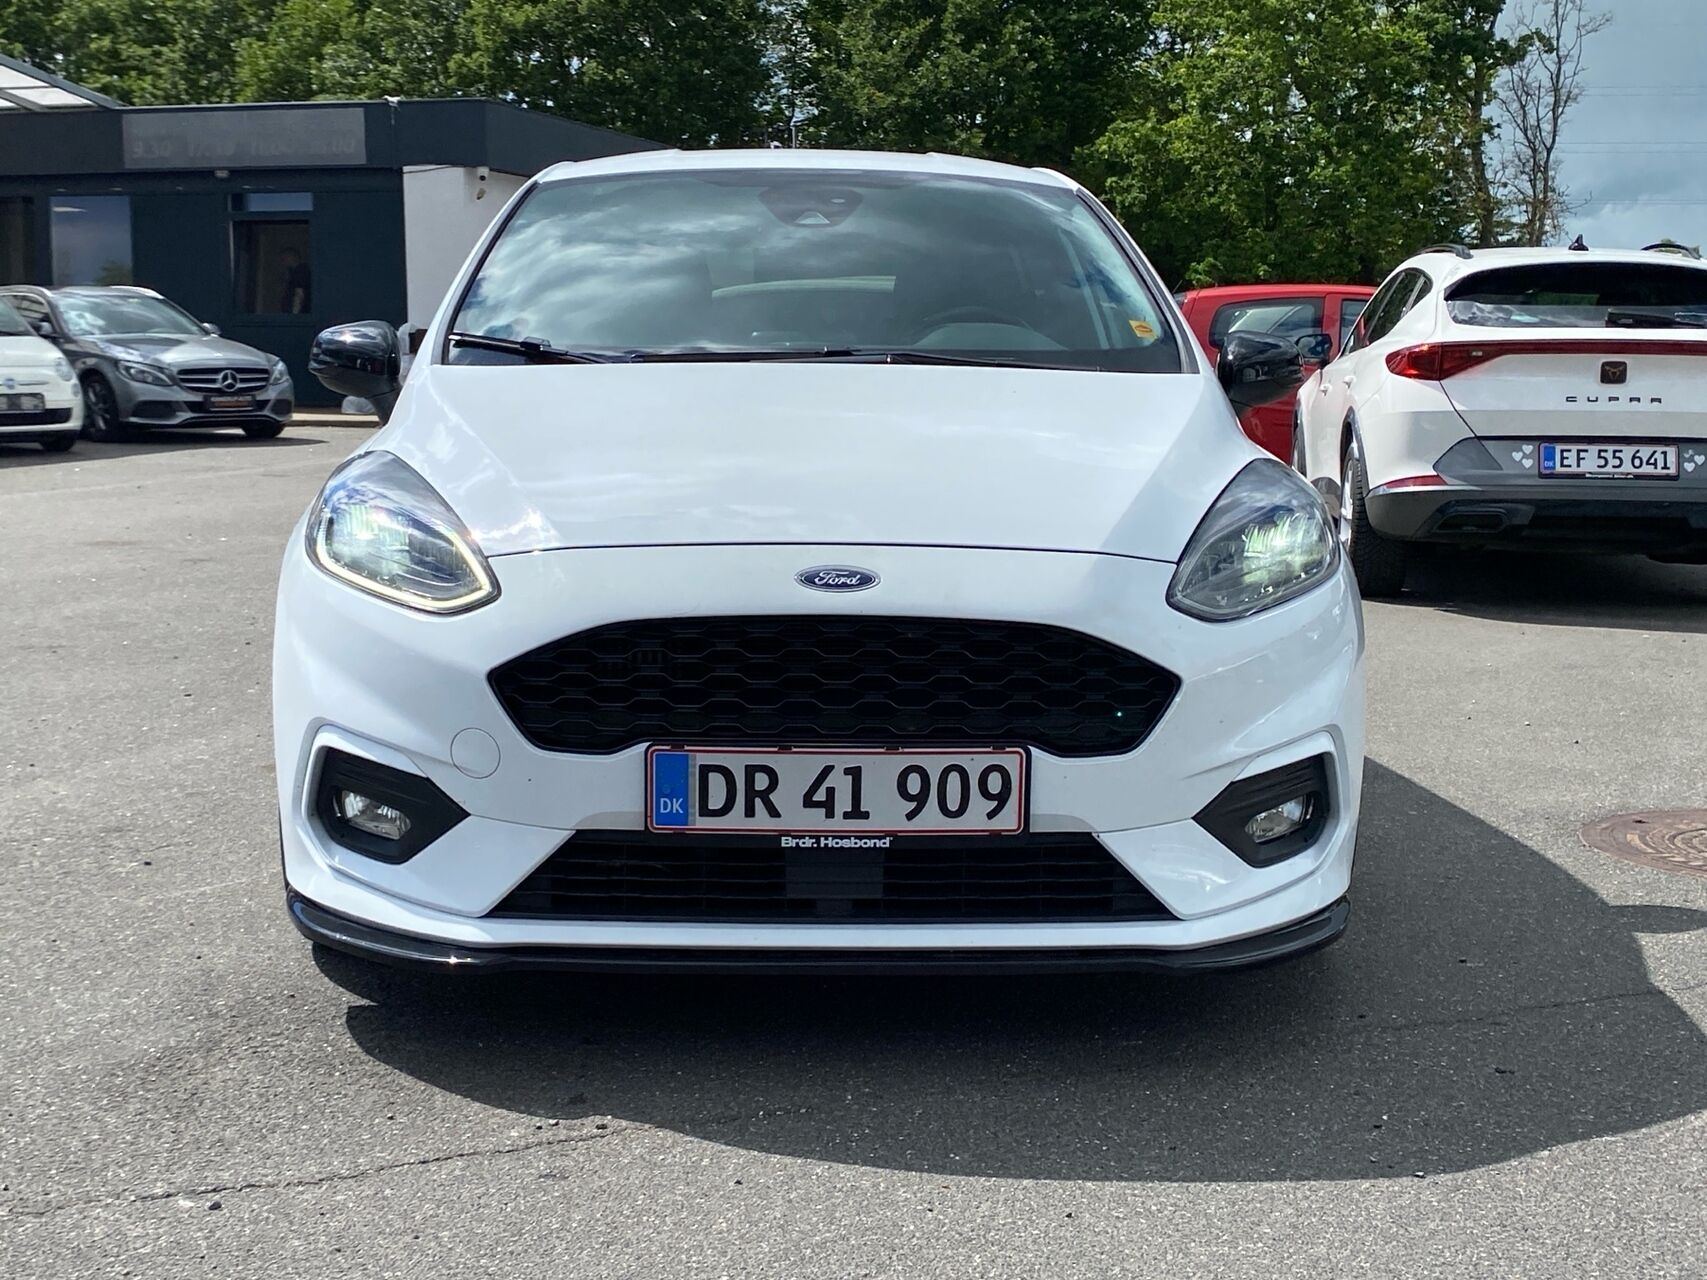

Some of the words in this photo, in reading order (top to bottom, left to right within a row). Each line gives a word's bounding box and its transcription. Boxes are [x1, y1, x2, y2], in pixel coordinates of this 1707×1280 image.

[1565, 396, 1662, 404] CUPRA
[1559, 449, 1588, 468] EF
[1597, 449, 1624, 469] 55
[1631, 449, 1671, 470] 641
[814, 571, 861, 585] Ford
[698, 763, 782, 818] DR
[802, 764, 870, 820] 41
[896, 763, 1013, 821] 909
[660, 798, 684, 814] DK
[781, 837, 818, 848] Brdr.
[820, 837, 890, 848] Hosbond
